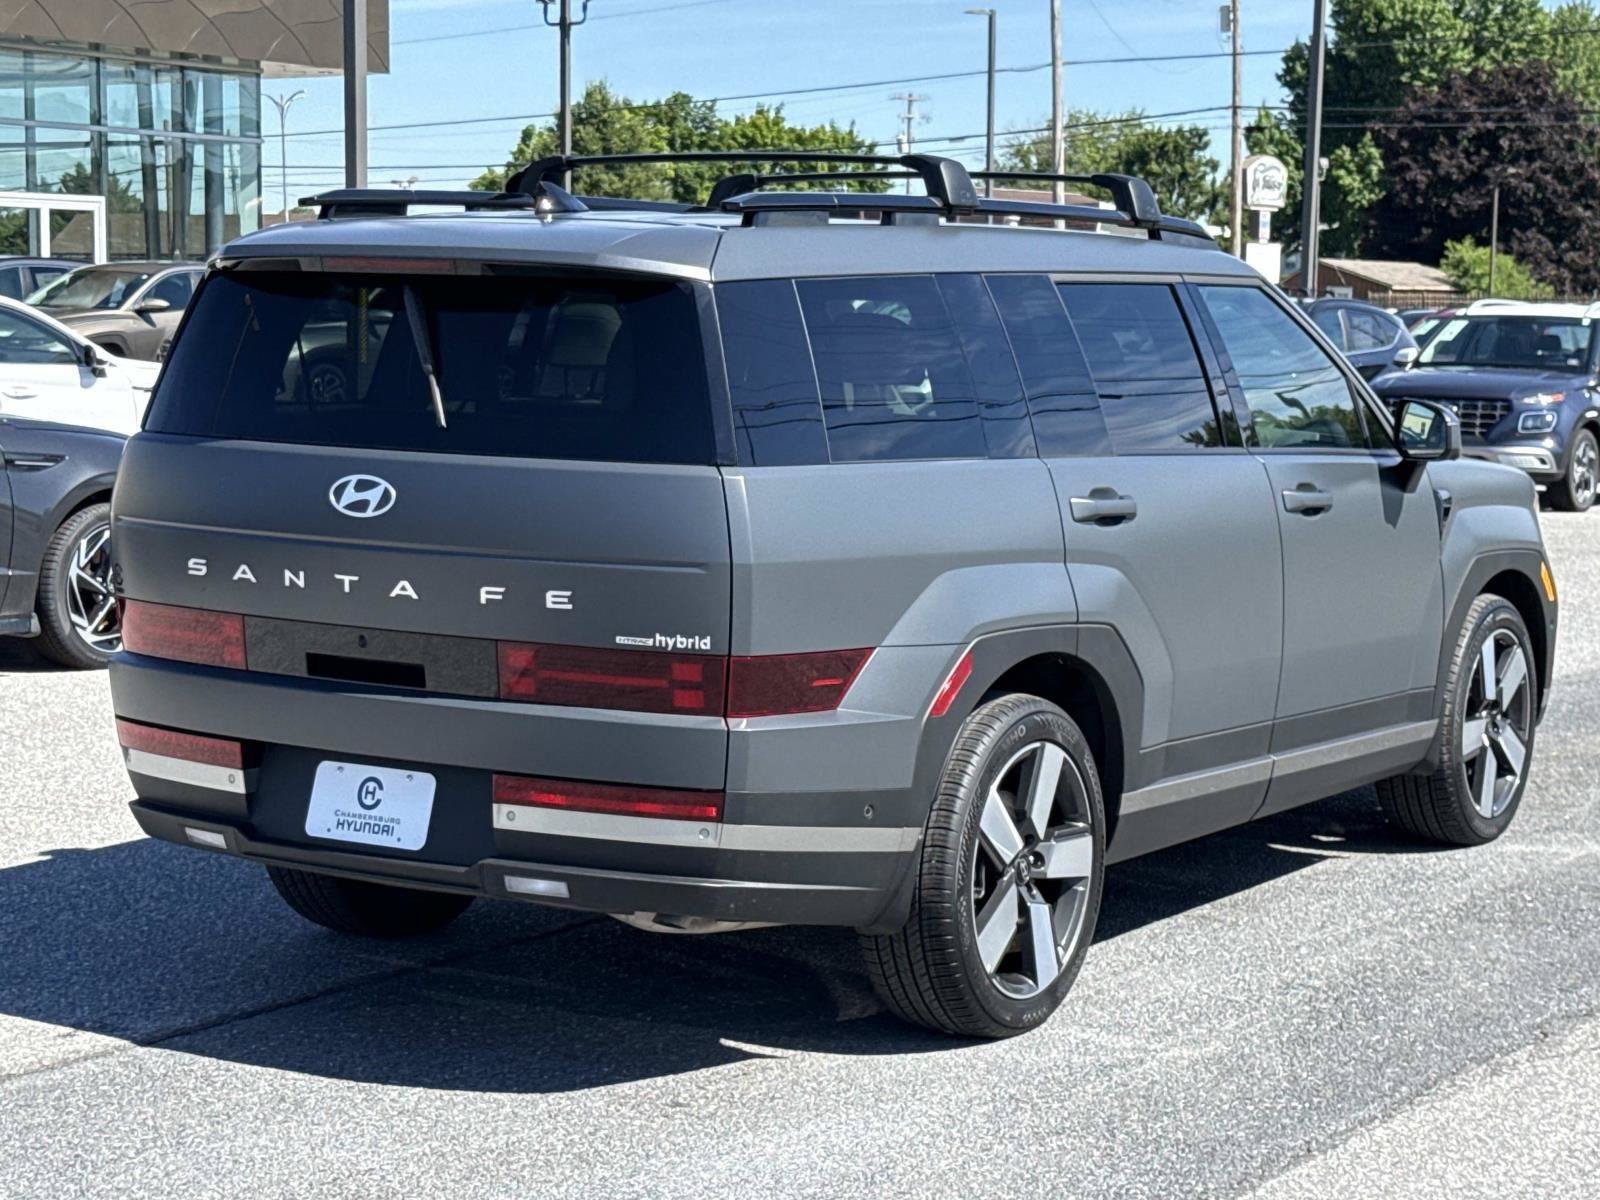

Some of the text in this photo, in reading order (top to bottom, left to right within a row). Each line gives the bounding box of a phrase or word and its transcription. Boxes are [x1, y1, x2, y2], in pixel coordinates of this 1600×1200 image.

[187, 558, 573, 610] SANTA FE
[655, 632, 711, 651] hybrid
[334, 809, 401, 825] CHAMBERSBURG
[336, 818, 395, 837] HYUNDAI
